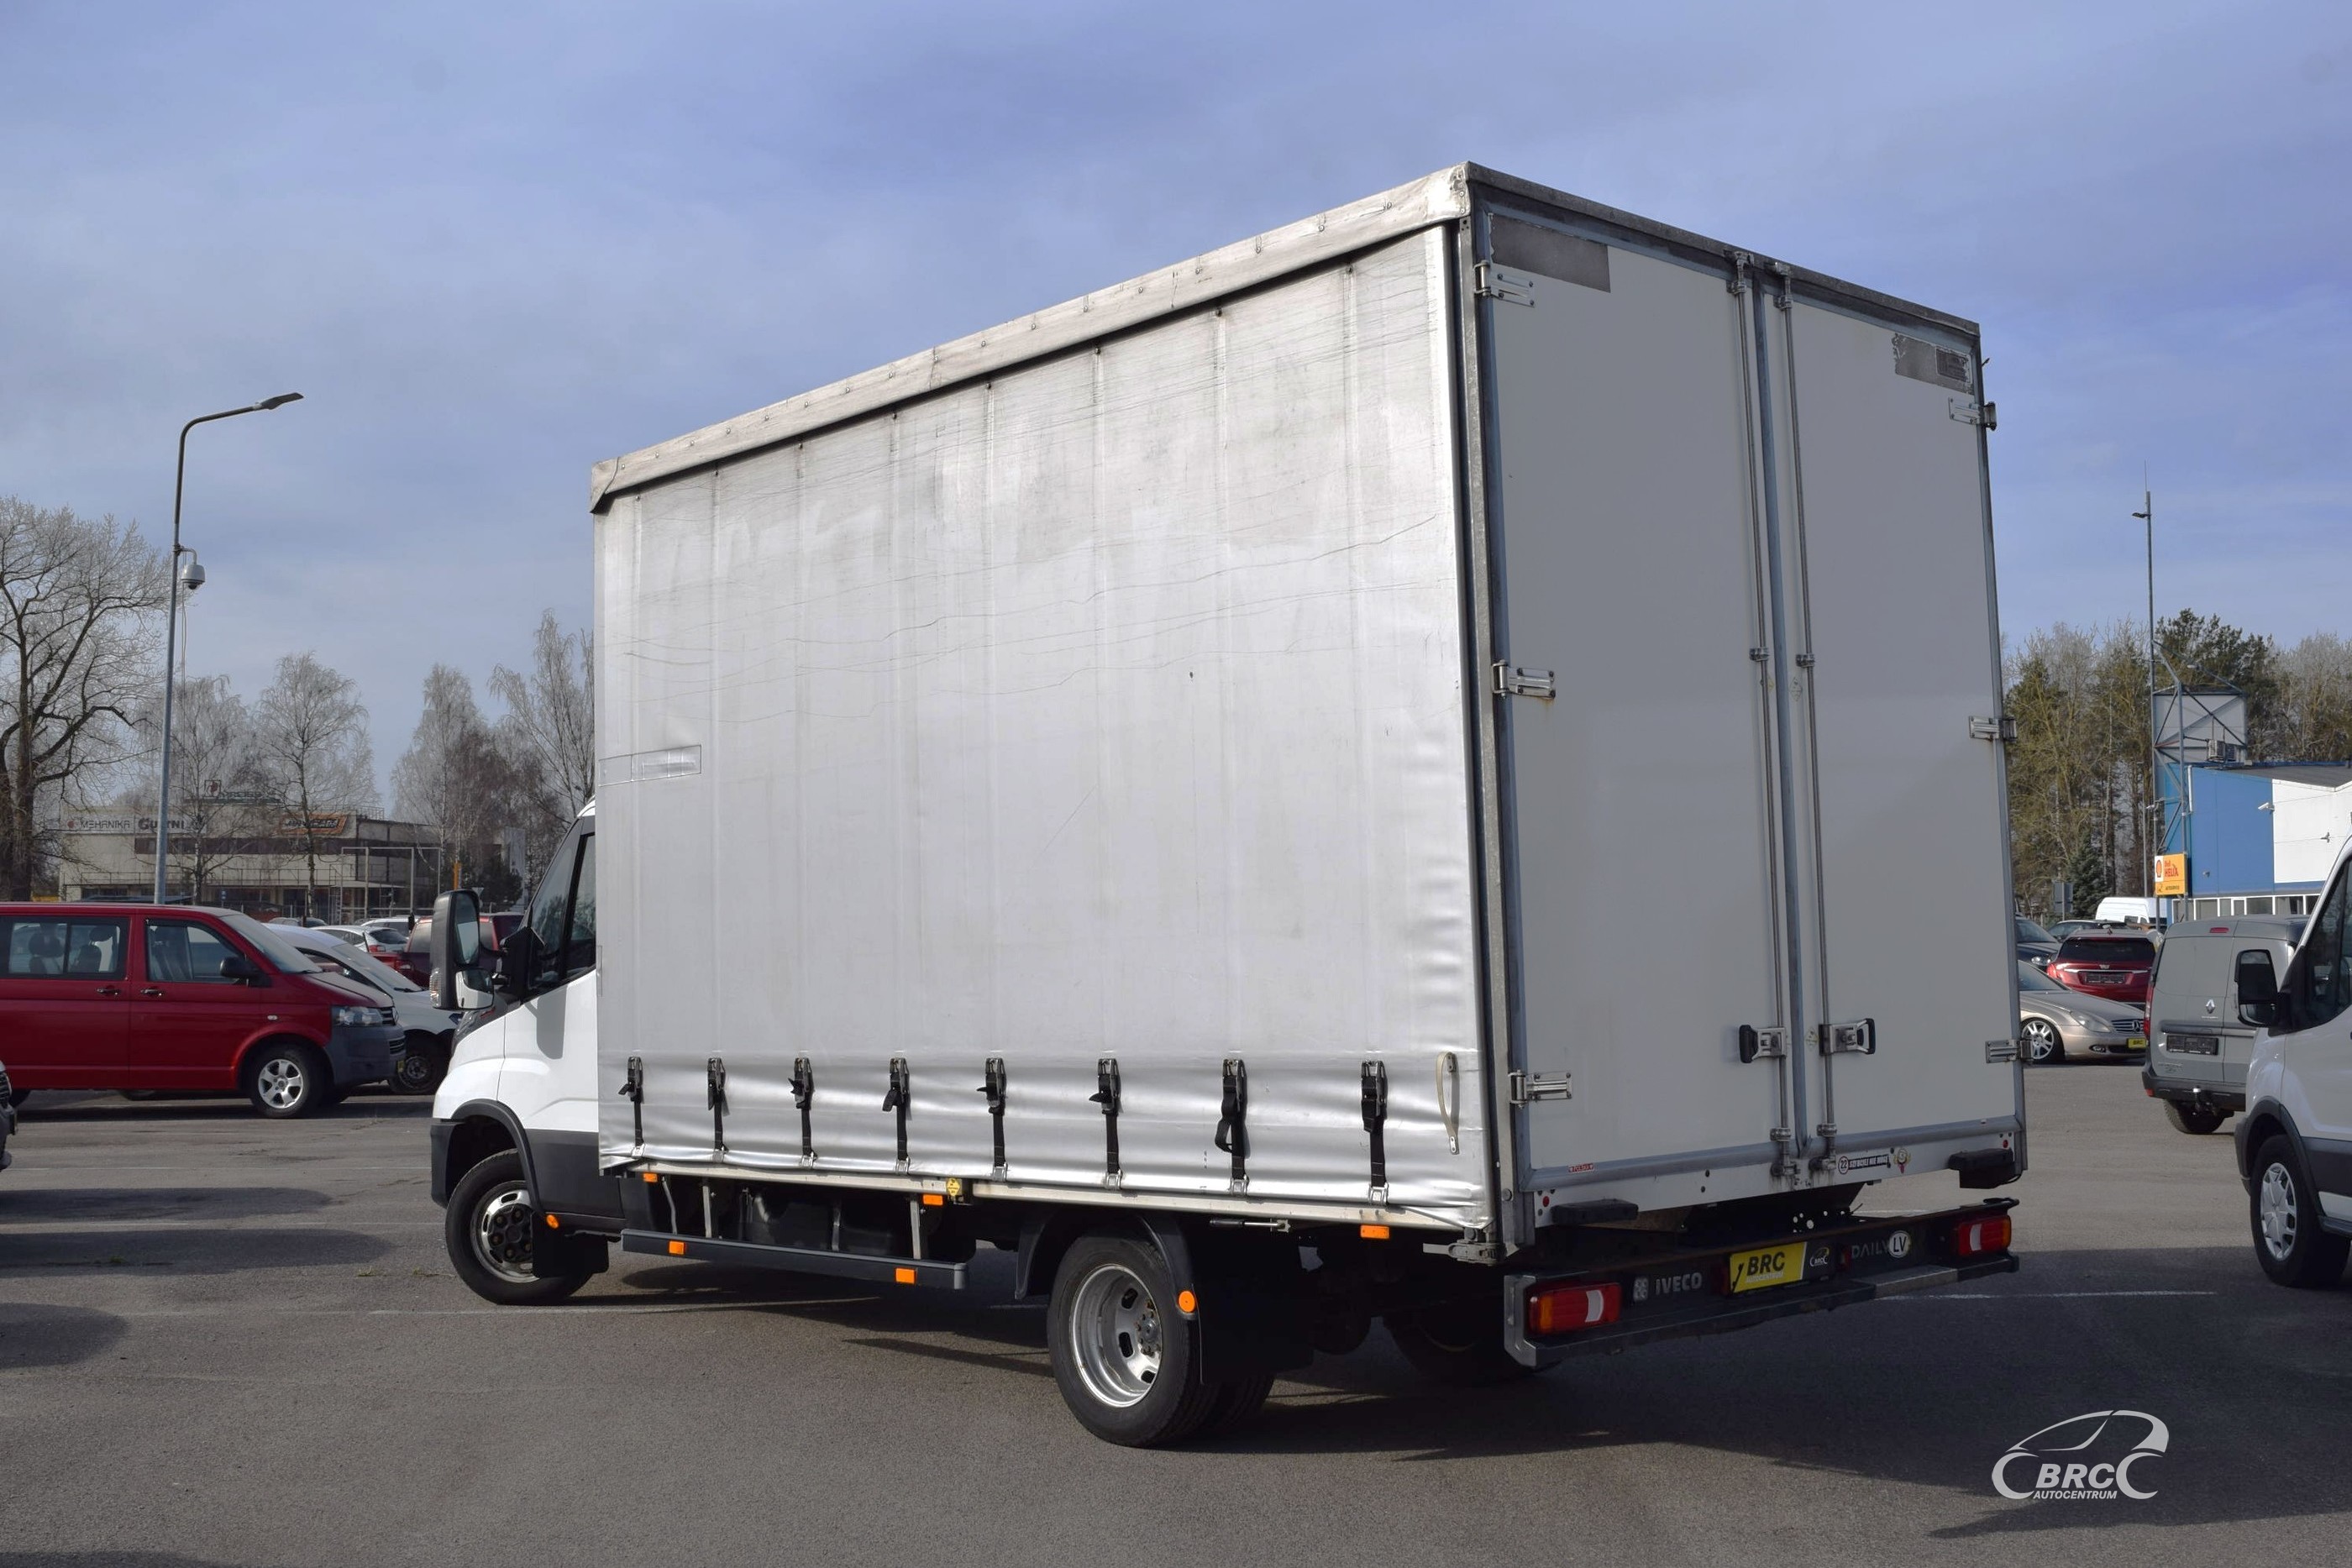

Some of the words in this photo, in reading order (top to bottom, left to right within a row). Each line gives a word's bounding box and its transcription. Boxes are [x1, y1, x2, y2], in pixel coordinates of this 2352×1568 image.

[81, 820, 130, 829] MEHANIKA
[1893, 1235, 1907, 1253] LV
[1746, 1251, 1785, 1276] BRC
[1656, 1272, 1703, 1295] IVECO
